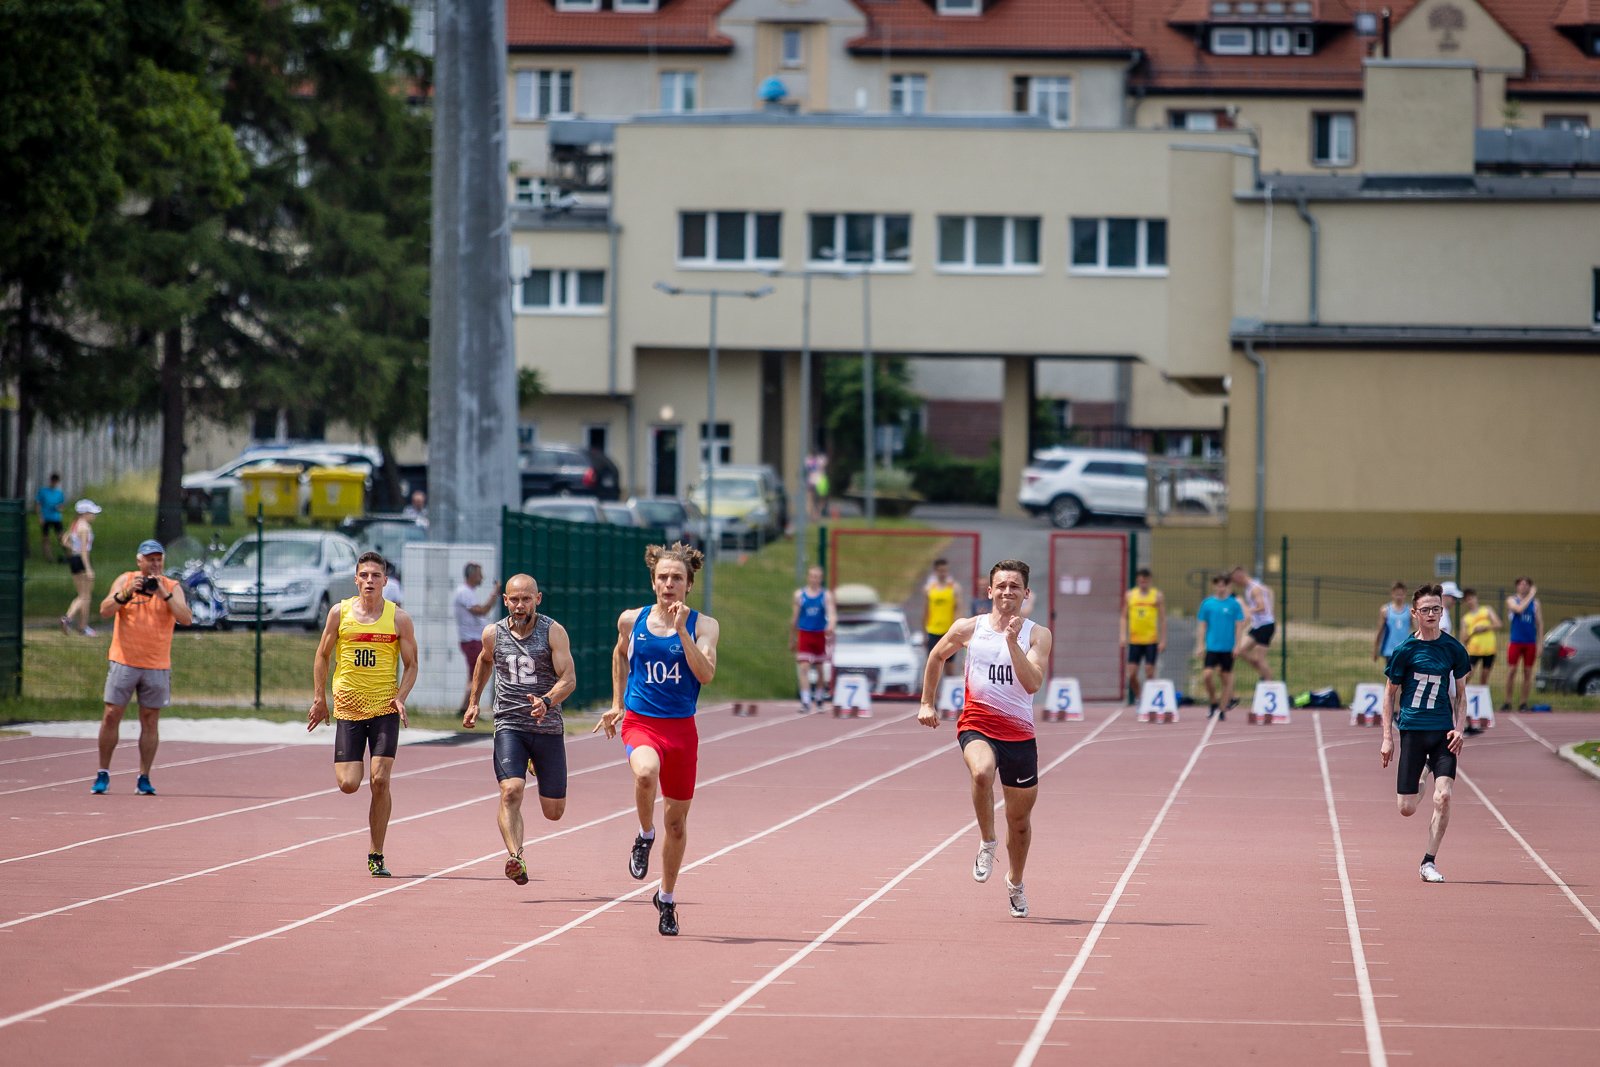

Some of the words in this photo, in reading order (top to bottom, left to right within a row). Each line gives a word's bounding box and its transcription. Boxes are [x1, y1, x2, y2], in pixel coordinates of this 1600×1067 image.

[354, 649, 376, 667] 305
[505, 654, 538, 684] 12
[645, 661, 682, 684] 104
[988, 664, 1013, 685] 444
[845, 684, 859, 708] 7
[951, 687, 964, 709] 6
[1057, 688, 1071, 710] 5
[1151, 690, 1166, 710] 4
[1264, 691, 1277, 713] 3
[1411, 672, 1442, 710] 77
[1363, 693, 1379, 715] 2
[1469, 695, 1480, 717] 1
